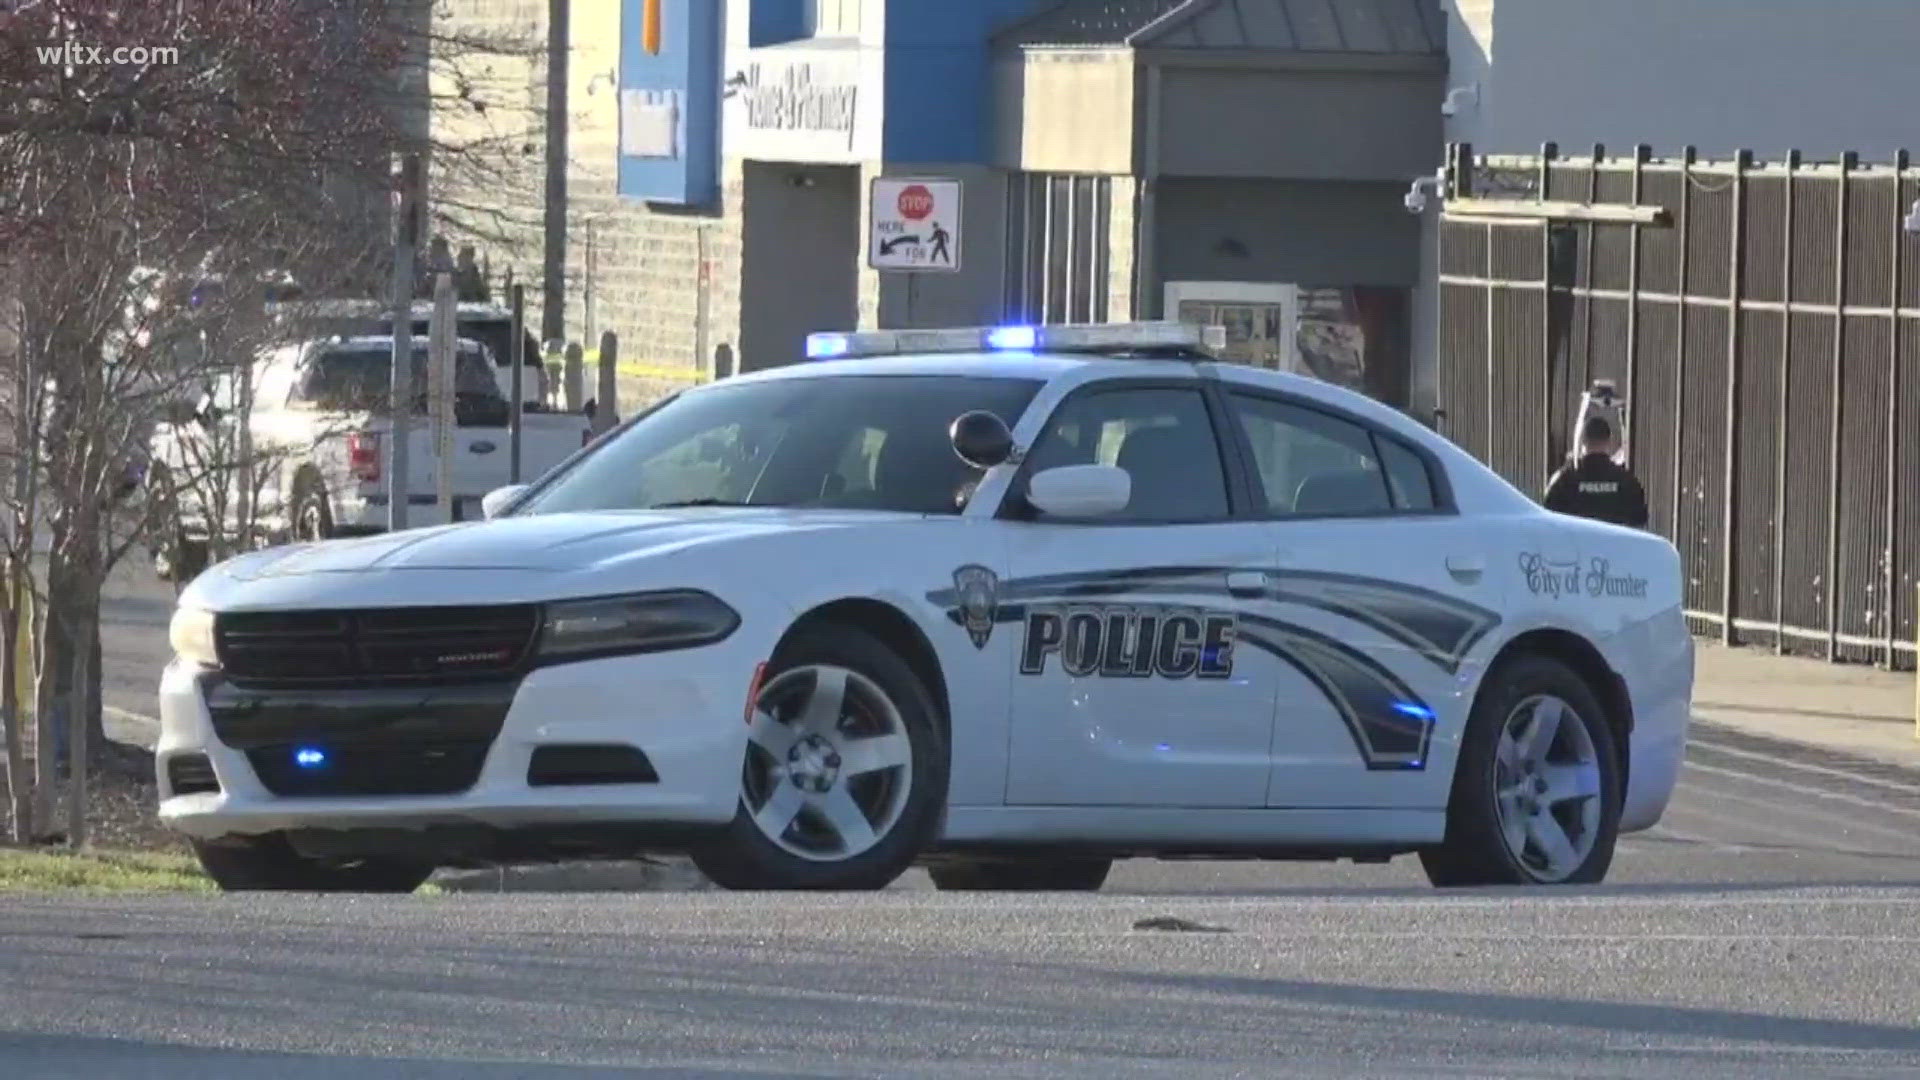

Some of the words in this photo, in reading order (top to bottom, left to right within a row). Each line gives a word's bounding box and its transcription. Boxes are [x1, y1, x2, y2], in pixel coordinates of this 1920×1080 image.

[899, 195, 932, 212] STOP
[1578, 481, 1618, 493] POLICE
[1518, 551, 1561, 600] City
[1565, 565, 1581, 595] of
[1585, 556, 1649, 599] Sumter
[1019, 605, 1236, 680] POLICE
